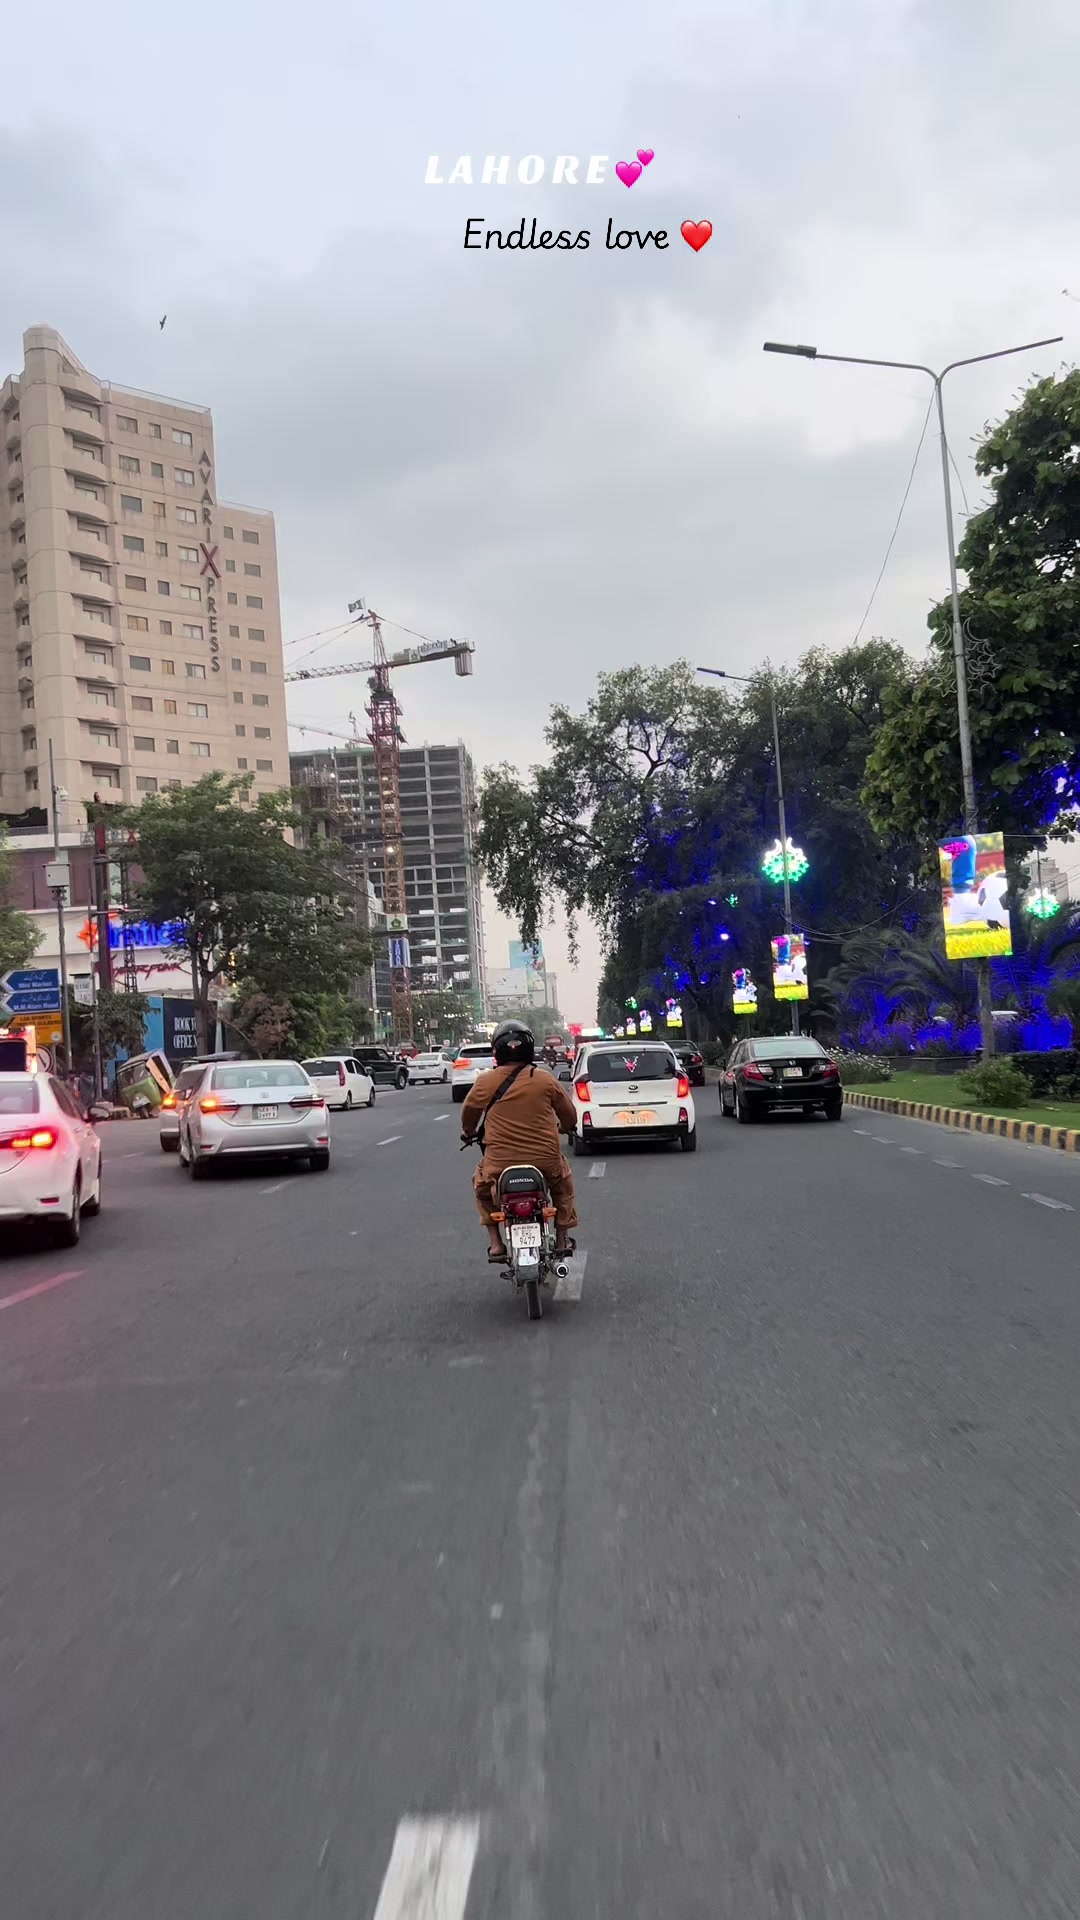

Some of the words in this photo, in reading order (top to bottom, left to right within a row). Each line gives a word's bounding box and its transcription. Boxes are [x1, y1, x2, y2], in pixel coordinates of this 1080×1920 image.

[200, 449, 214, 543] AVARI
[174, 1017, 190, 1030] BOOK
[174, 1034, 192, 1048] OFFICE
